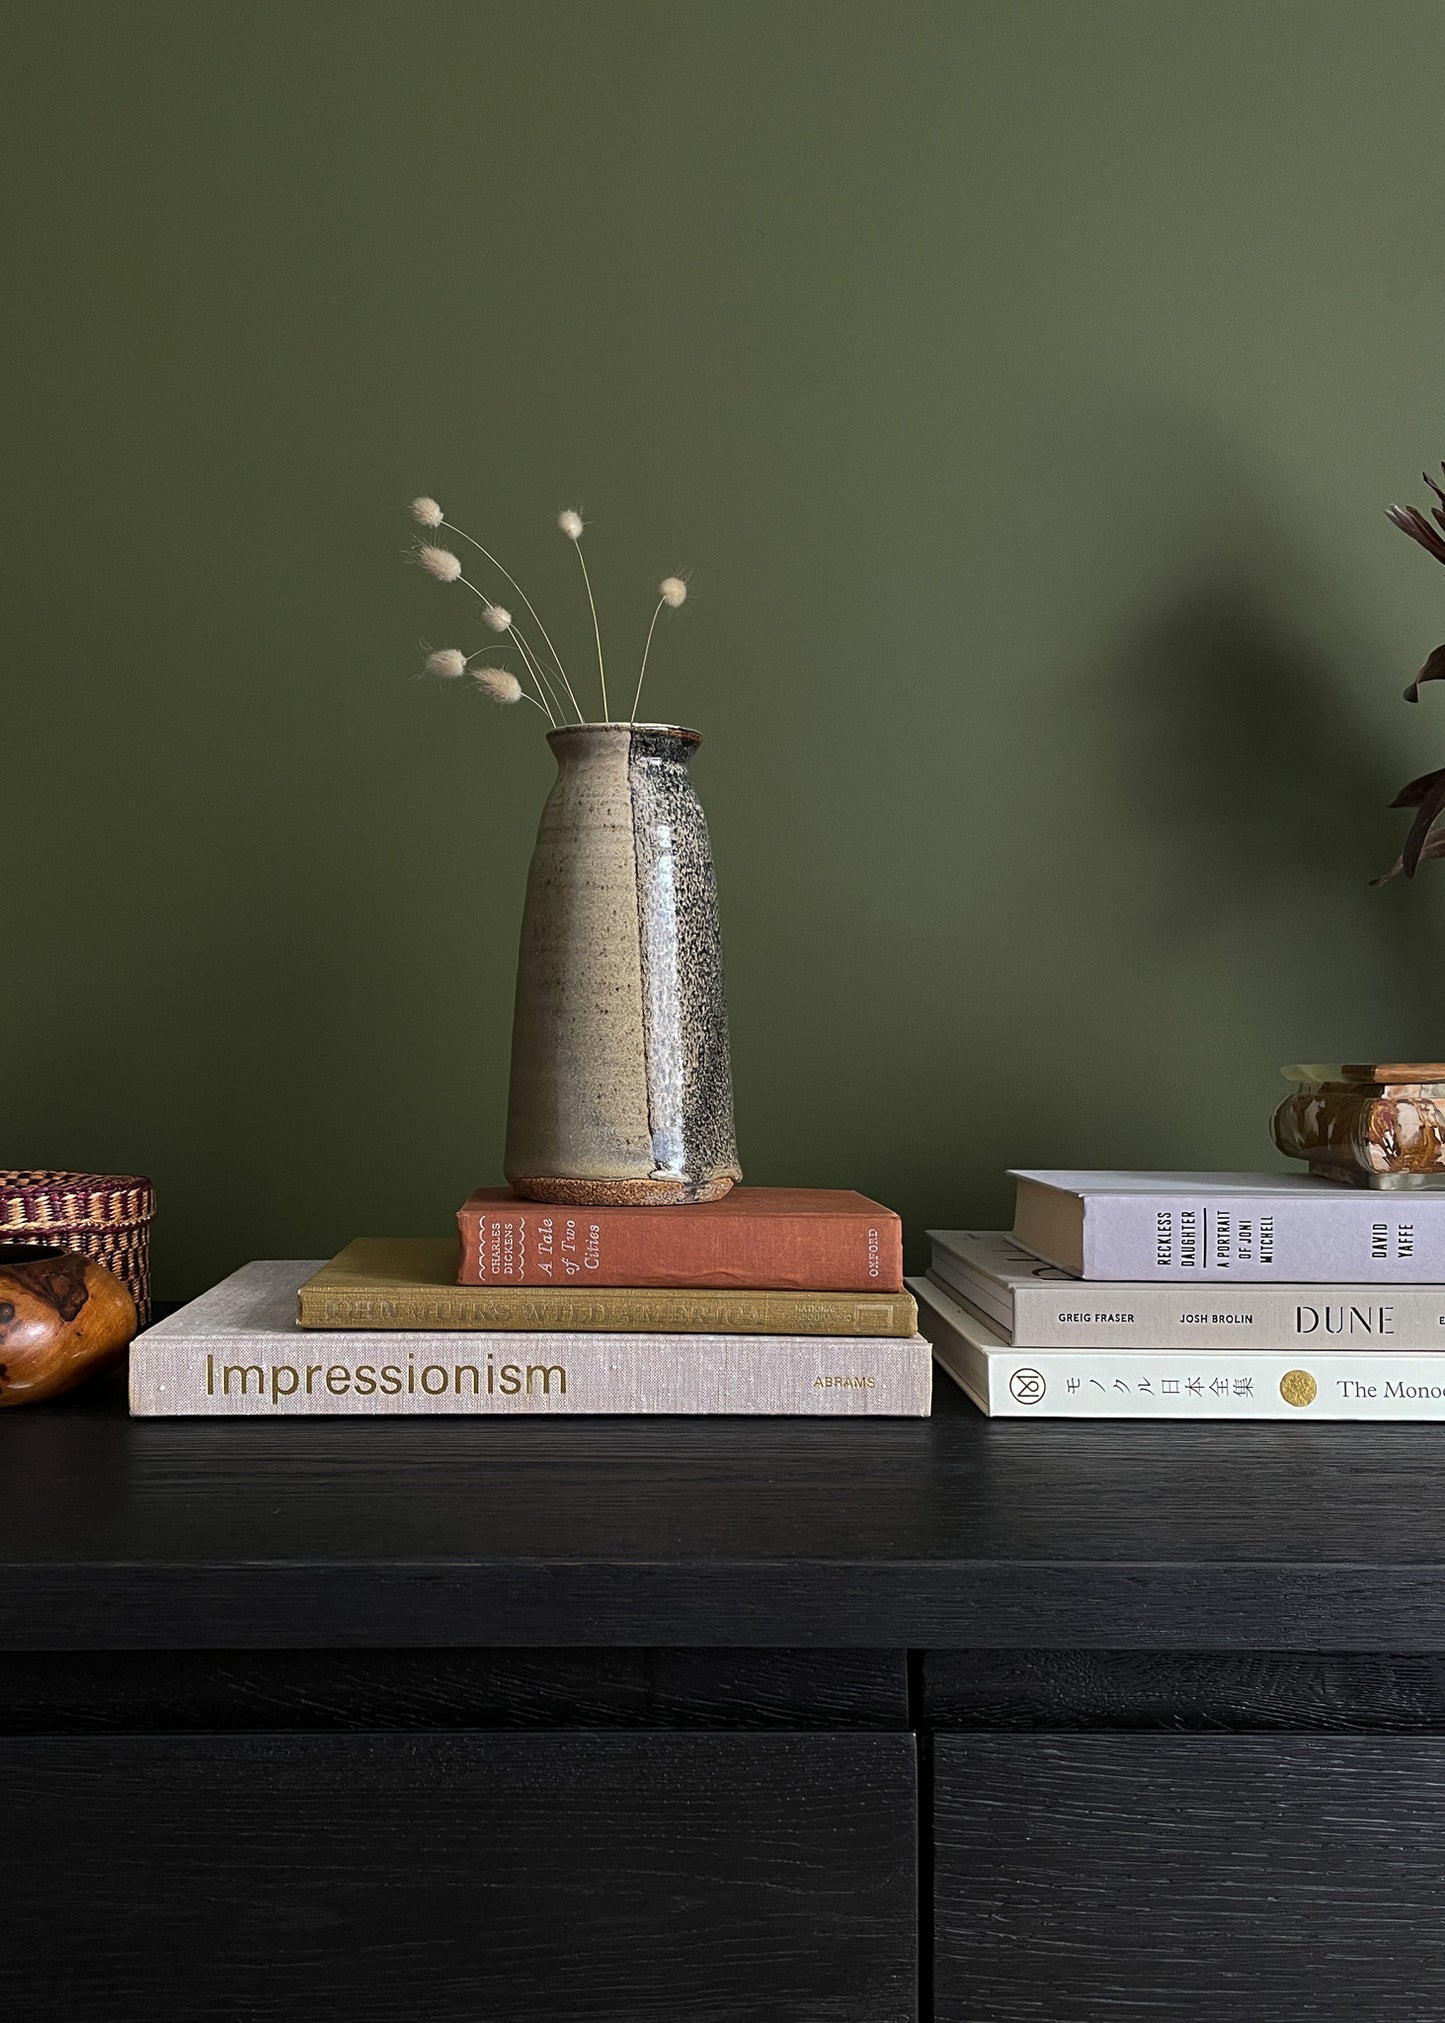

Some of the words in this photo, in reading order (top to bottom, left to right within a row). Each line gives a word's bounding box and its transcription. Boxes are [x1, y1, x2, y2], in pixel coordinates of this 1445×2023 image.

[491, 1222, 501, 1274] CHARLES
[504, 1223, 513, 1275] DICKENS
[538, 1218, 553, 1255] Tale
[561, 1220, 576, 1252] Two
[584, 1224, 600, 1270] Cities
[1157, 1211, 1172, 1266] RECKLESS
[1181, 1211, 1196, 1267] DAUGHTER
[1217, 1210, 1230, 1260] PORTRAIT
[1239, 1219, 1252, 1244] JONI
[1260, 1215, 1274, 1264] MITCHELL
[1372, 1223, 1388, 1259] DAVID
[1398, 1223, 1414, 1259] YAFFE
[538, 1261, 553, 1277] A
[562, 1257, 580, 1276] of
[868, 1228, 880, 1278] OXFORD
[1239, 1244, 1252, 1260] OF
[1058, 1313, 1092, 1323] GREIG
[1094, 1313, 1135, 1323] FRASER
[1179, 1314, 1208, 1324] JOSH
[1211, 1314, 1253, 1325] BROLIN
[1296, 1306, 1395, 1334] DUNE
[206, 1353, 567, 1406] Impressionism
[812, 1377, 876, 1389] ABRAMS
[1066, 1376, 1254, 1398] モノクル日本全集
[1336, 1380, 1378, 1398] The
[1383, 1381, 1445, 1399] Mono
